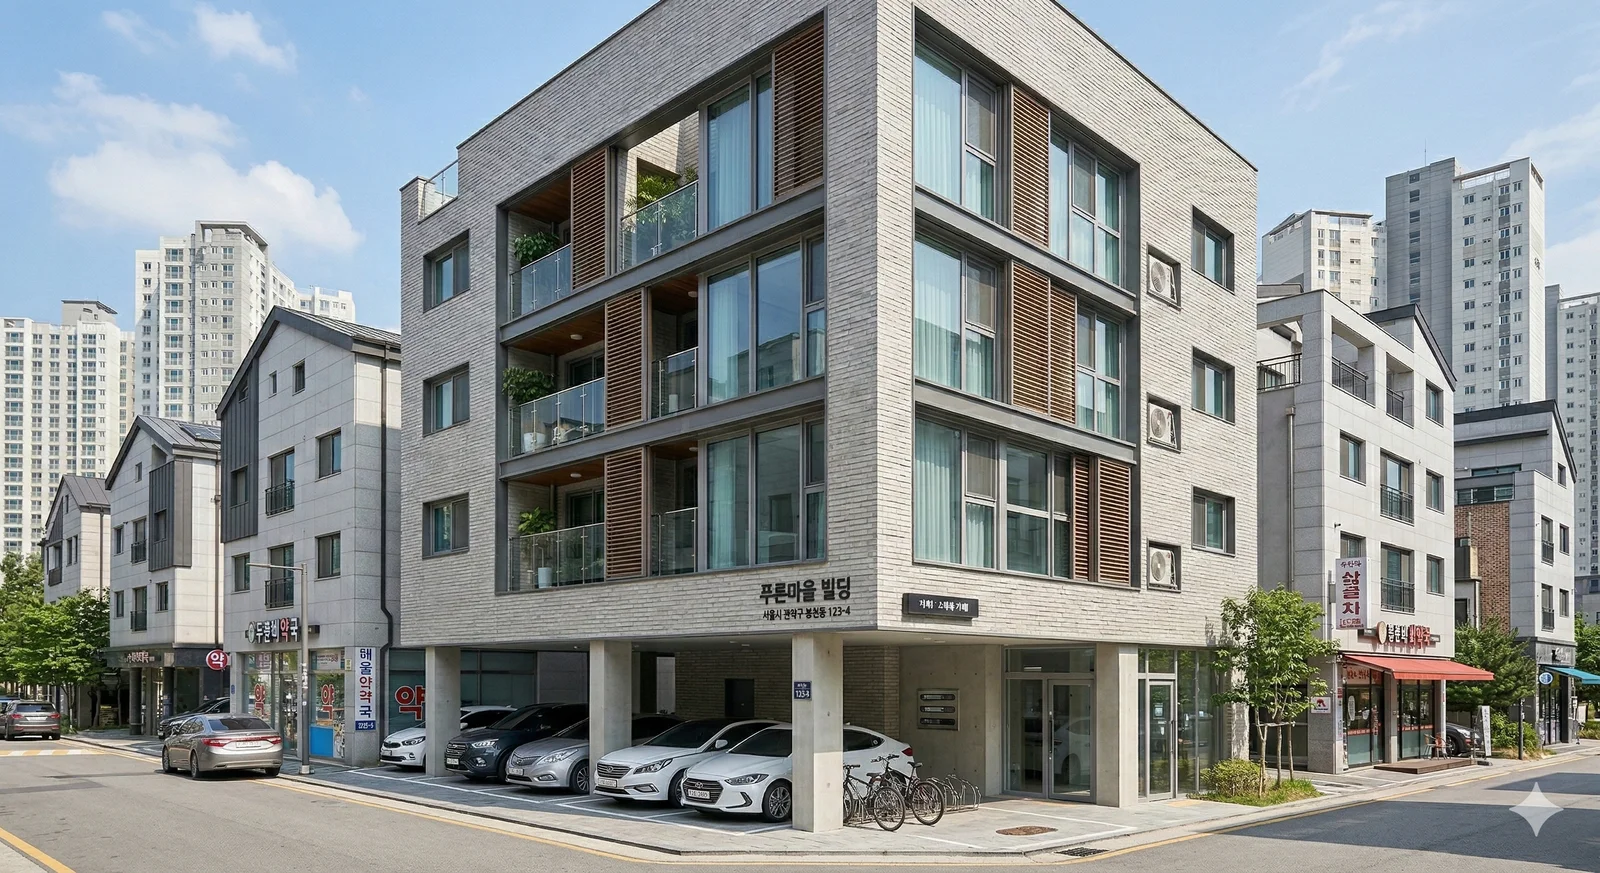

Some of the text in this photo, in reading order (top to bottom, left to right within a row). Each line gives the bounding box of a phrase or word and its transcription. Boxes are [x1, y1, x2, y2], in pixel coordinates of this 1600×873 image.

[760, 576, 850, 605] 푸른마을 빌딩
[828, 605, 851, 617] 123-4
[210, 652, 225, 668] 약
[321, 684, 334, 720] 약
[394, 685, 426, 721] 약
